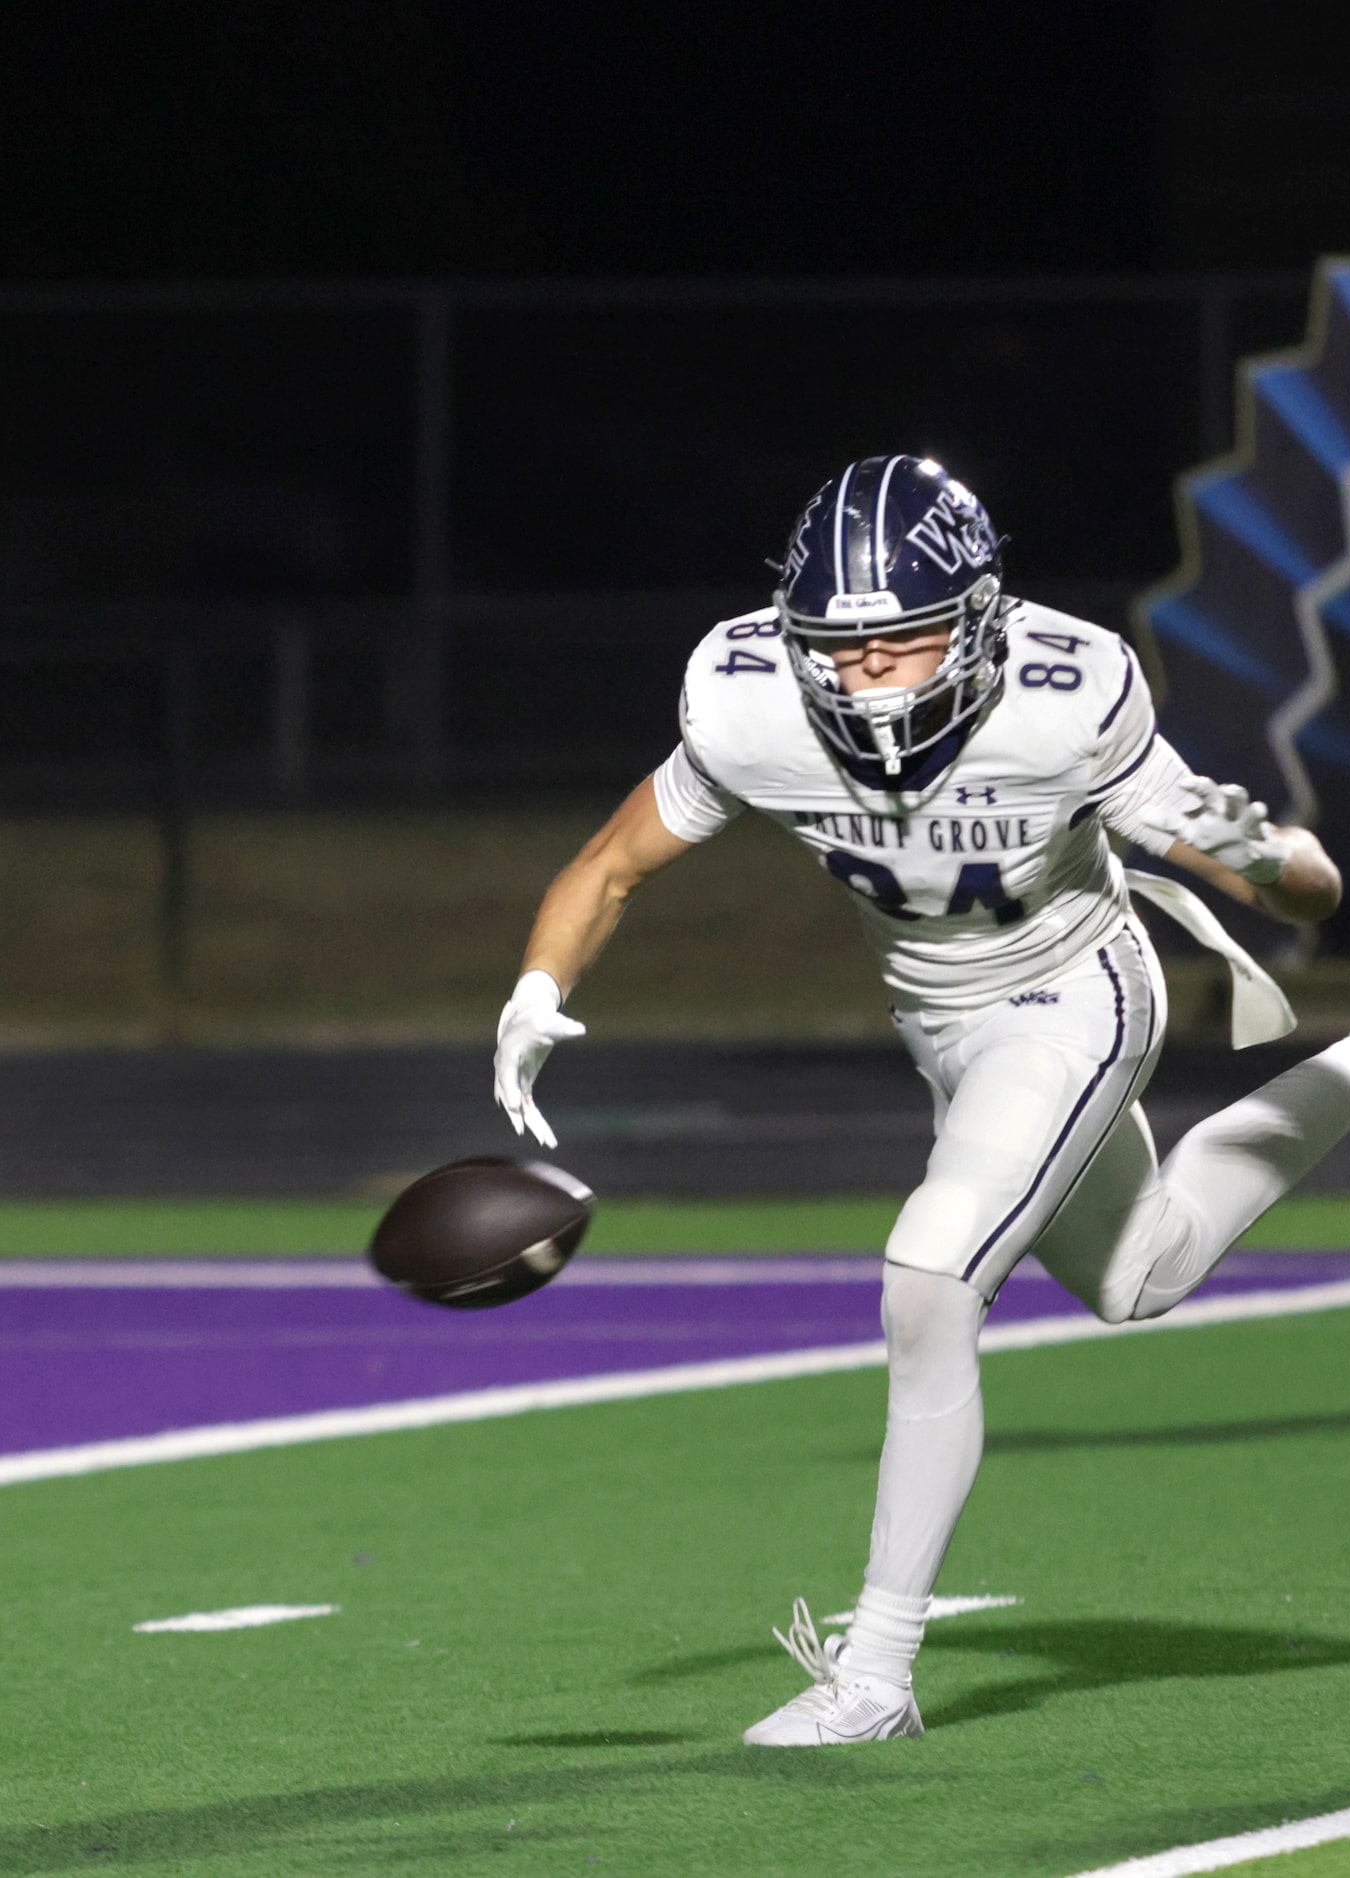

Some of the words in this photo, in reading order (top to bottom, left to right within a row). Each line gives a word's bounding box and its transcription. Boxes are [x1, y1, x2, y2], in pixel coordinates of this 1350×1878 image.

[715, 620, 783, 675] 84
[1019, 631, 1091, 692] 84
[928, 819, 1029, 852] GROVE
